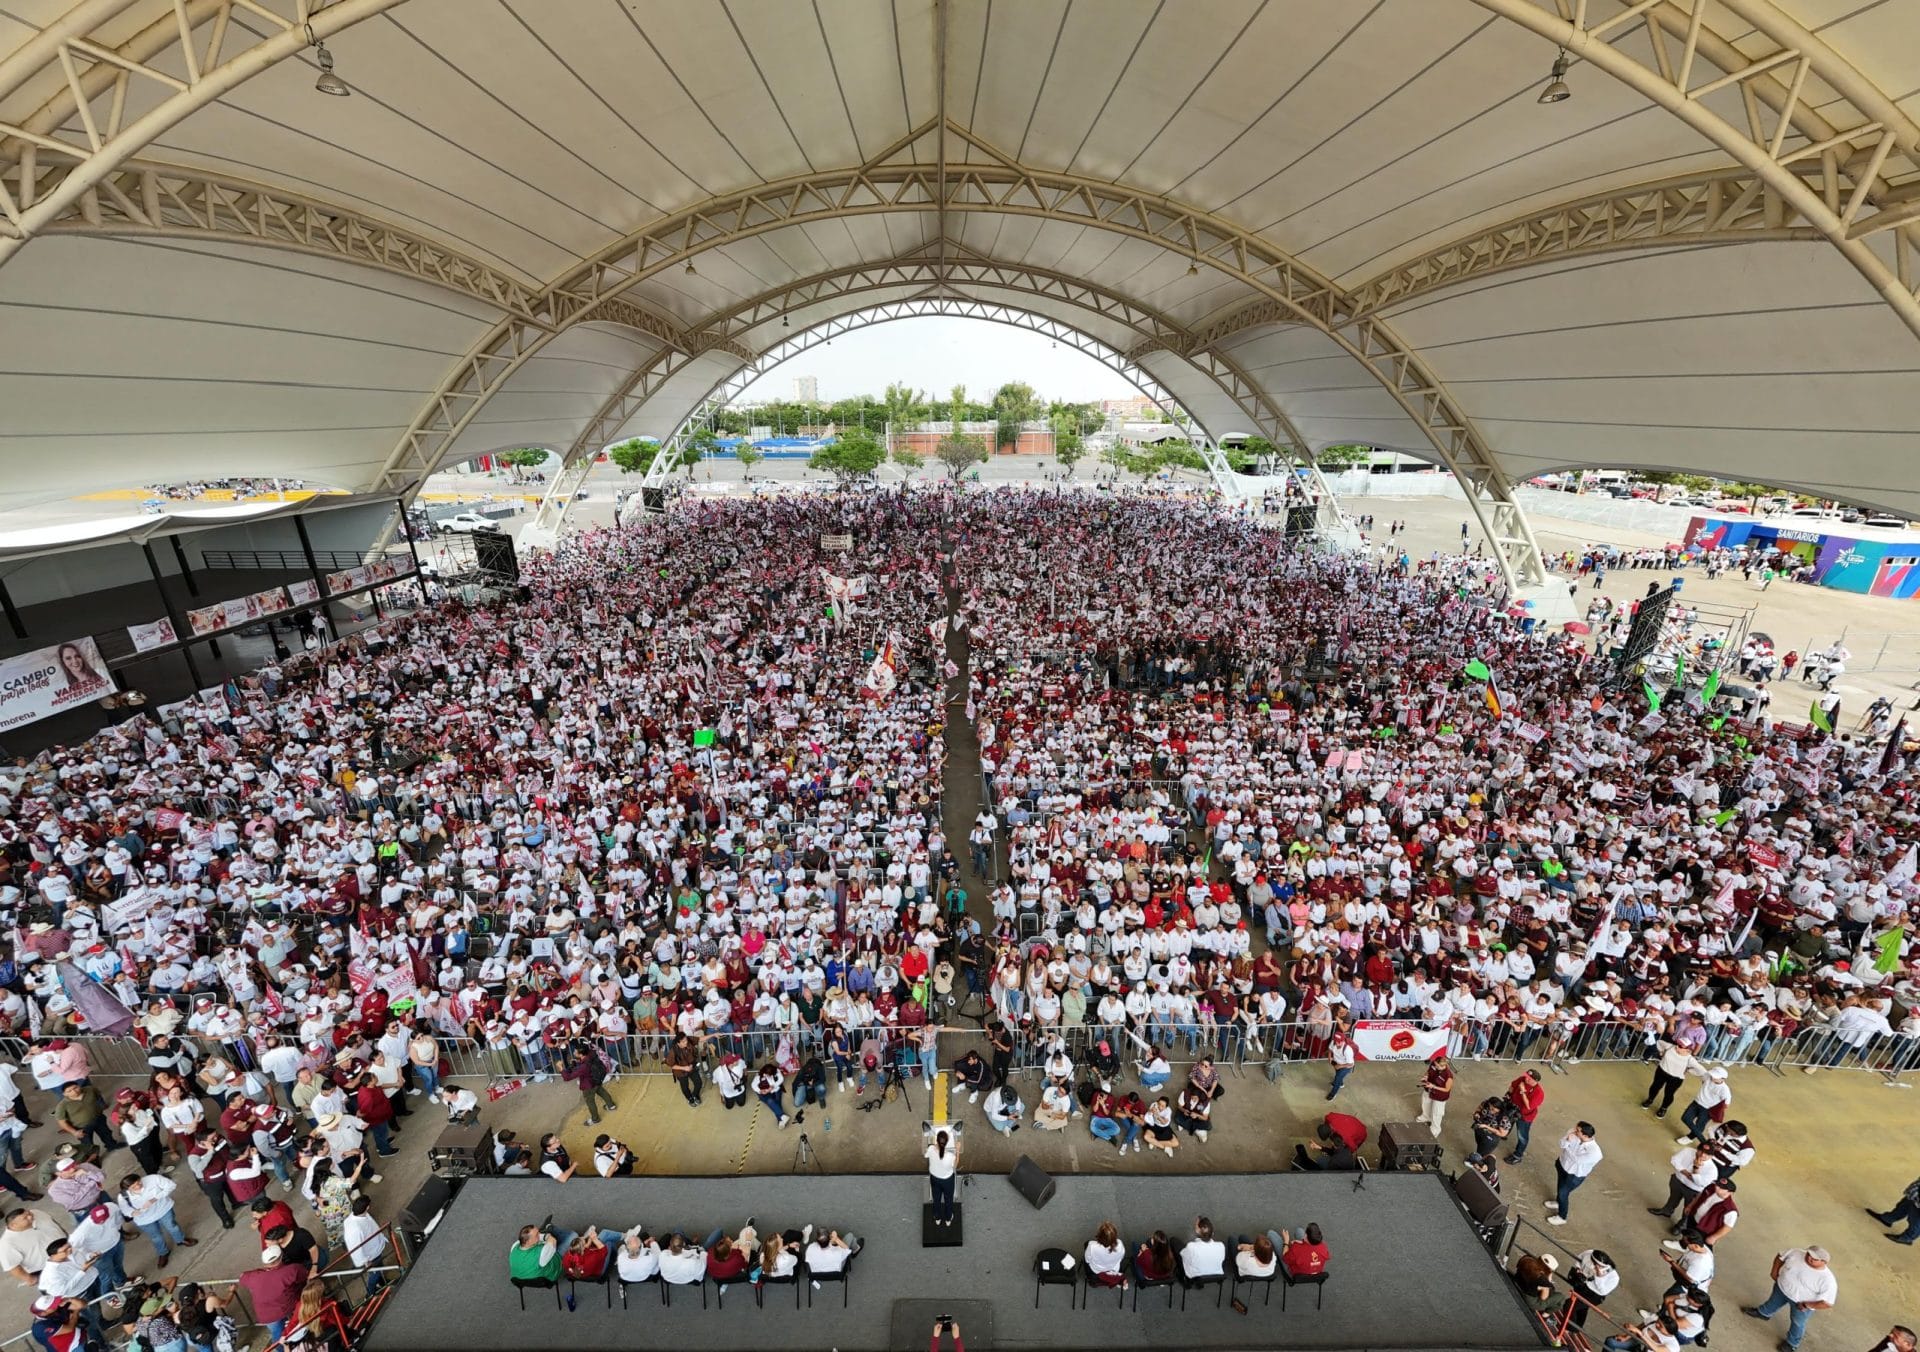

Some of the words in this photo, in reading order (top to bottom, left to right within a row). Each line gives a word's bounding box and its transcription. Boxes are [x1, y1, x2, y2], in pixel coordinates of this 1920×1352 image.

[1776, 529, 1820, 543] SANITARIOS
[3, 666, 56, 690] CAMBIO
[54, 678, 103, 698] VANESSA
[0, 688, 27, 706] para
[28, 677, 50, 693] todos
[51, 691, 83, 706] MONTES
[84, 685, 95, 693] DE
[0, 711, 37, 728] morena
